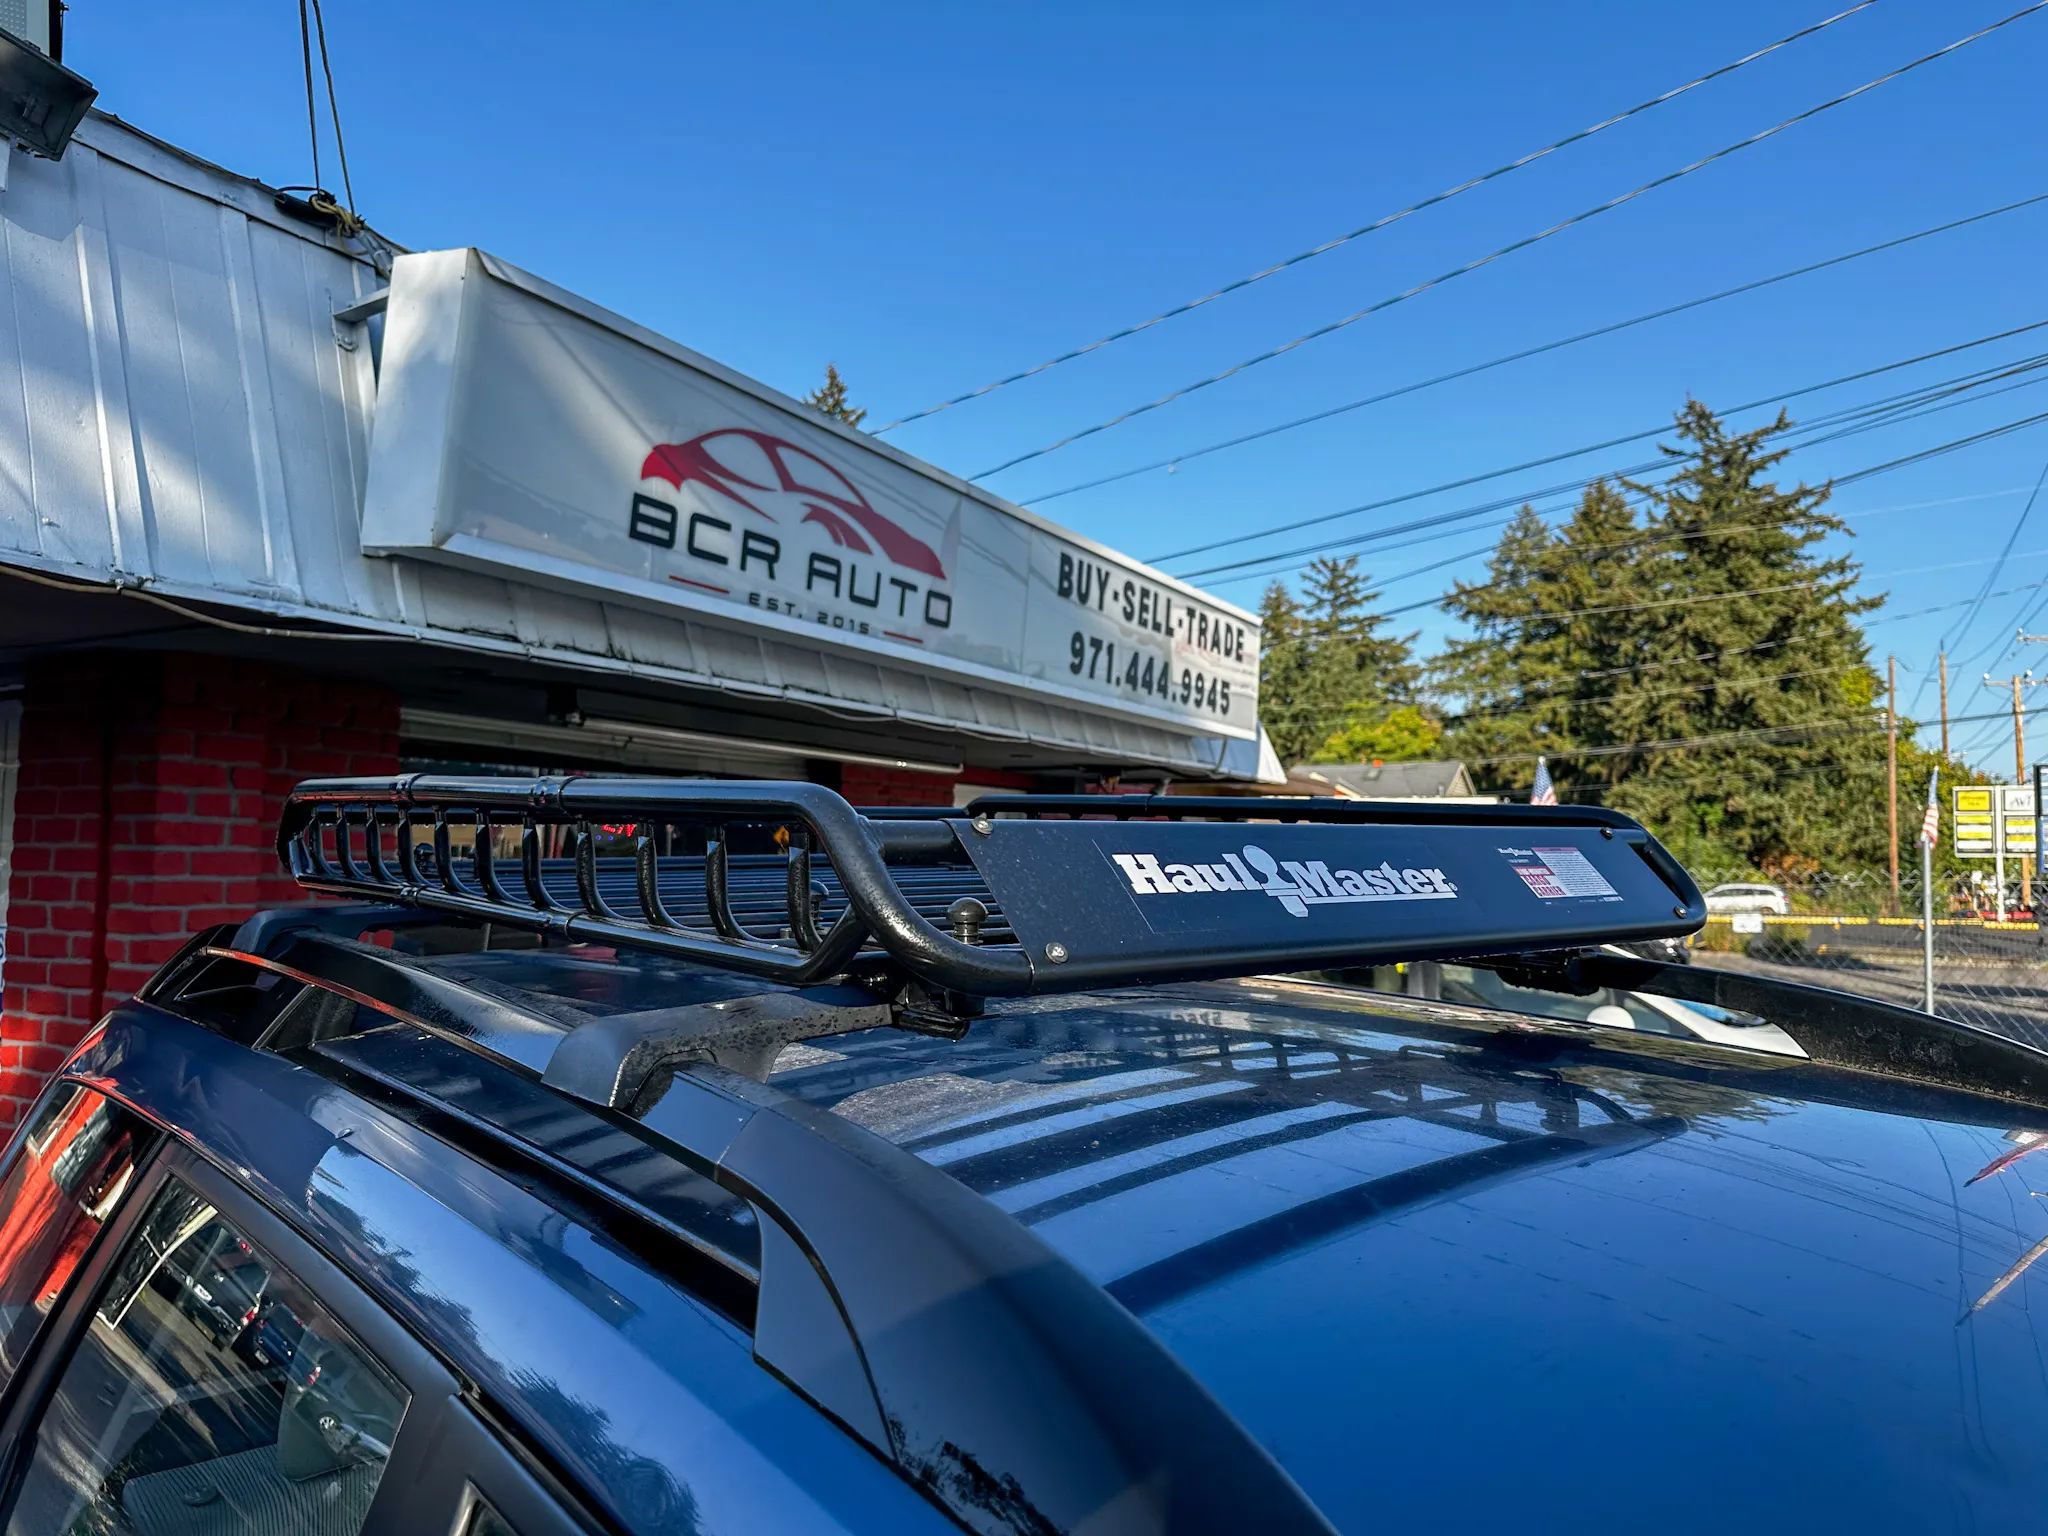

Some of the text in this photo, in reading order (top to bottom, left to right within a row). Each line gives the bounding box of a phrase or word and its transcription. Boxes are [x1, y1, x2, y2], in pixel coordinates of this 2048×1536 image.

[629, 493, 953, 628] BCR AUTO
[748, 592, 870, 634] EST. 2015
[1069, 631, 1231, 715] 971.444.9945
[1112, 853, 1263, 895] Haul
